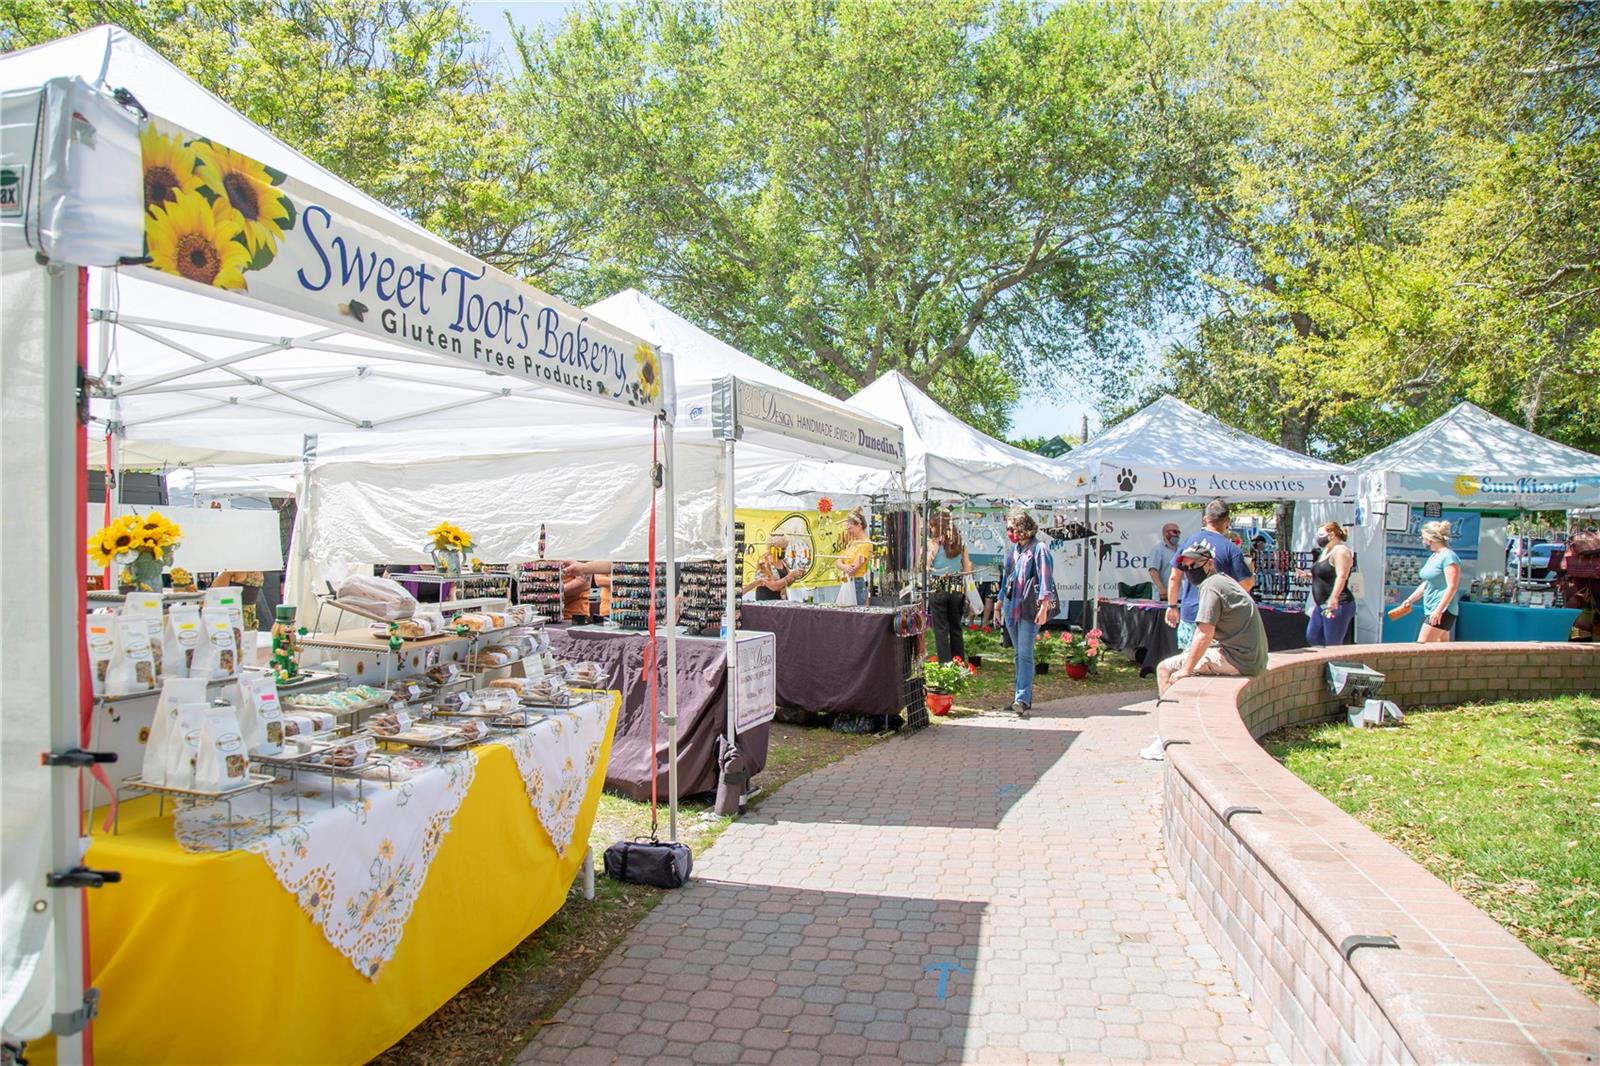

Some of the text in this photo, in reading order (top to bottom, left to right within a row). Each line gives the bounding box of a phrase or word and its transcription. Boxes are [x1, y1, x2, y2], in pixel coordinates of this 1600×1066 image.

[297, 205, 627, 398] Sweet Toot's Bakery
[381, 309, 593, 392] Gluten Free Products
[796, 415, 833, 439] HANDMADE
[833, 427, 858, 444] JEWELRY
[858, 428, 899, 459] Dunedin,
[1162, 471, 1305, 495] Dog Accessories
